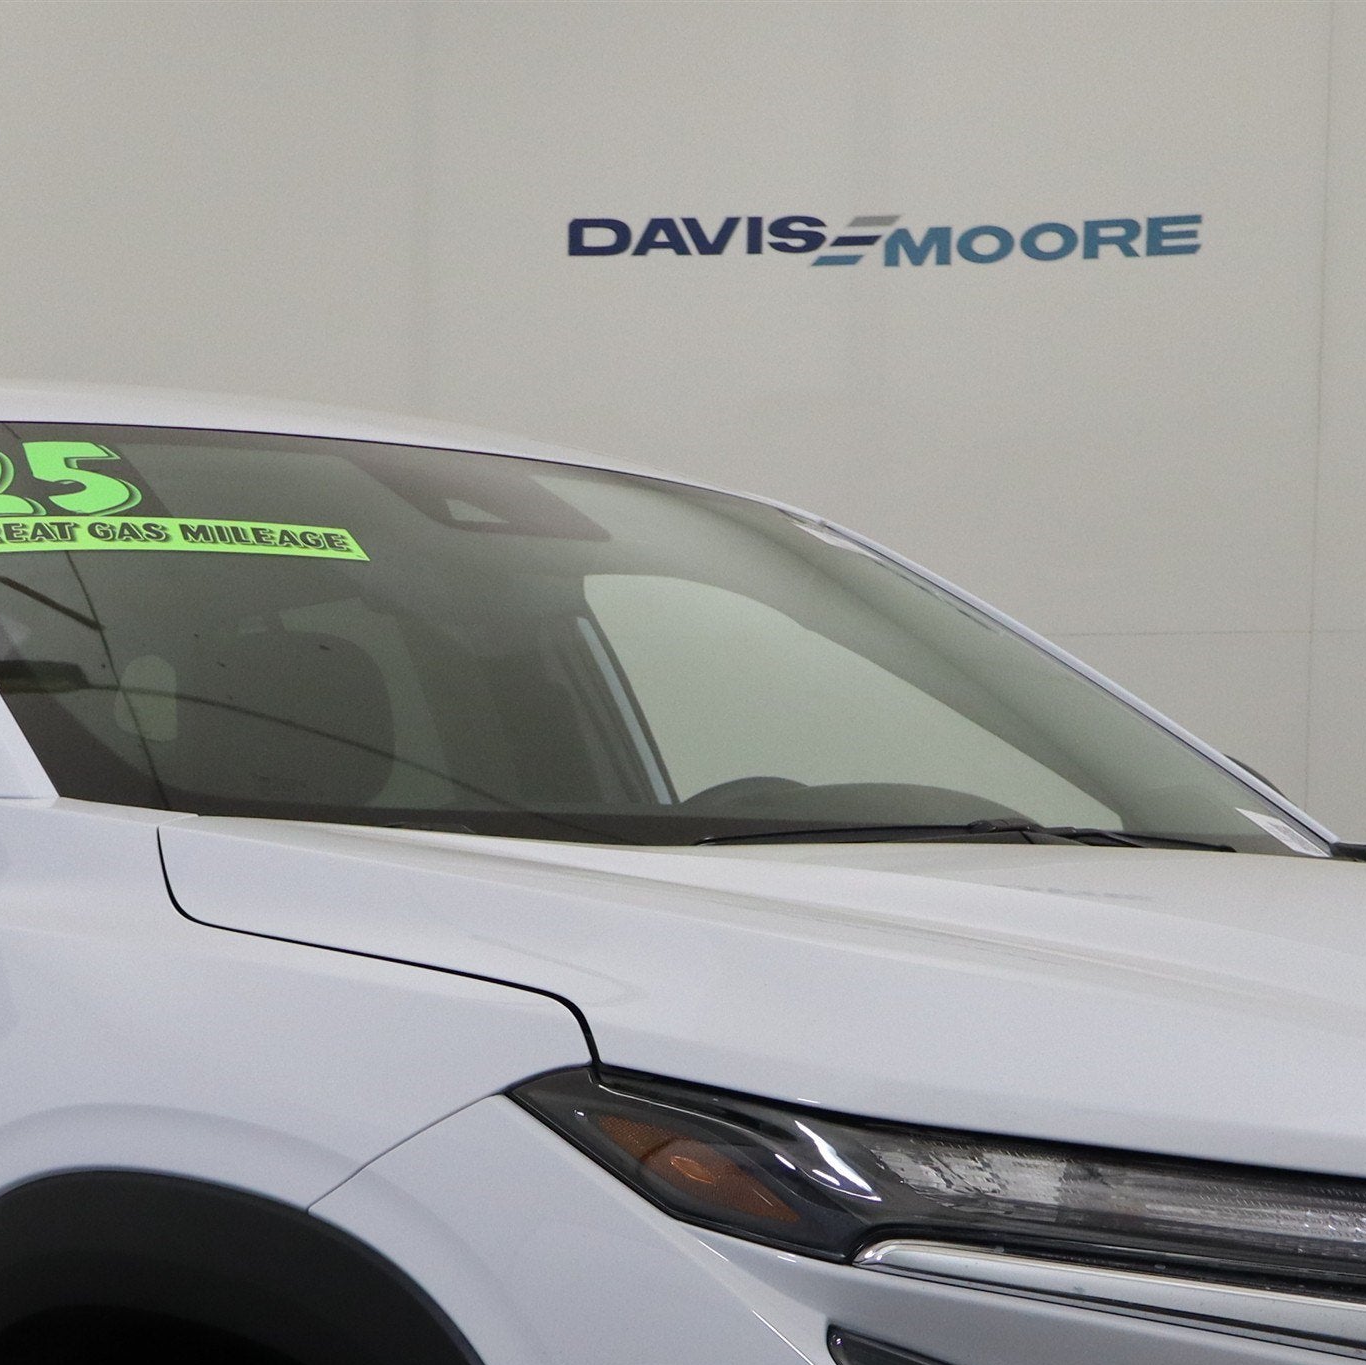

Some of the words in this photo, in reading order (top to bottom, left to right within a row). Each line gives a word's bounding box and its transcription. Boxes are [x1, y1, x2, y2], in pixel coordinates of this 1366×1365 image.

[567, 215, 828, 257] DAVIS
[882, 214, 1203, 267] MOORE
[88, 521, 176, 543] GAS
[180, 524, 352, 551] MILEAGE
